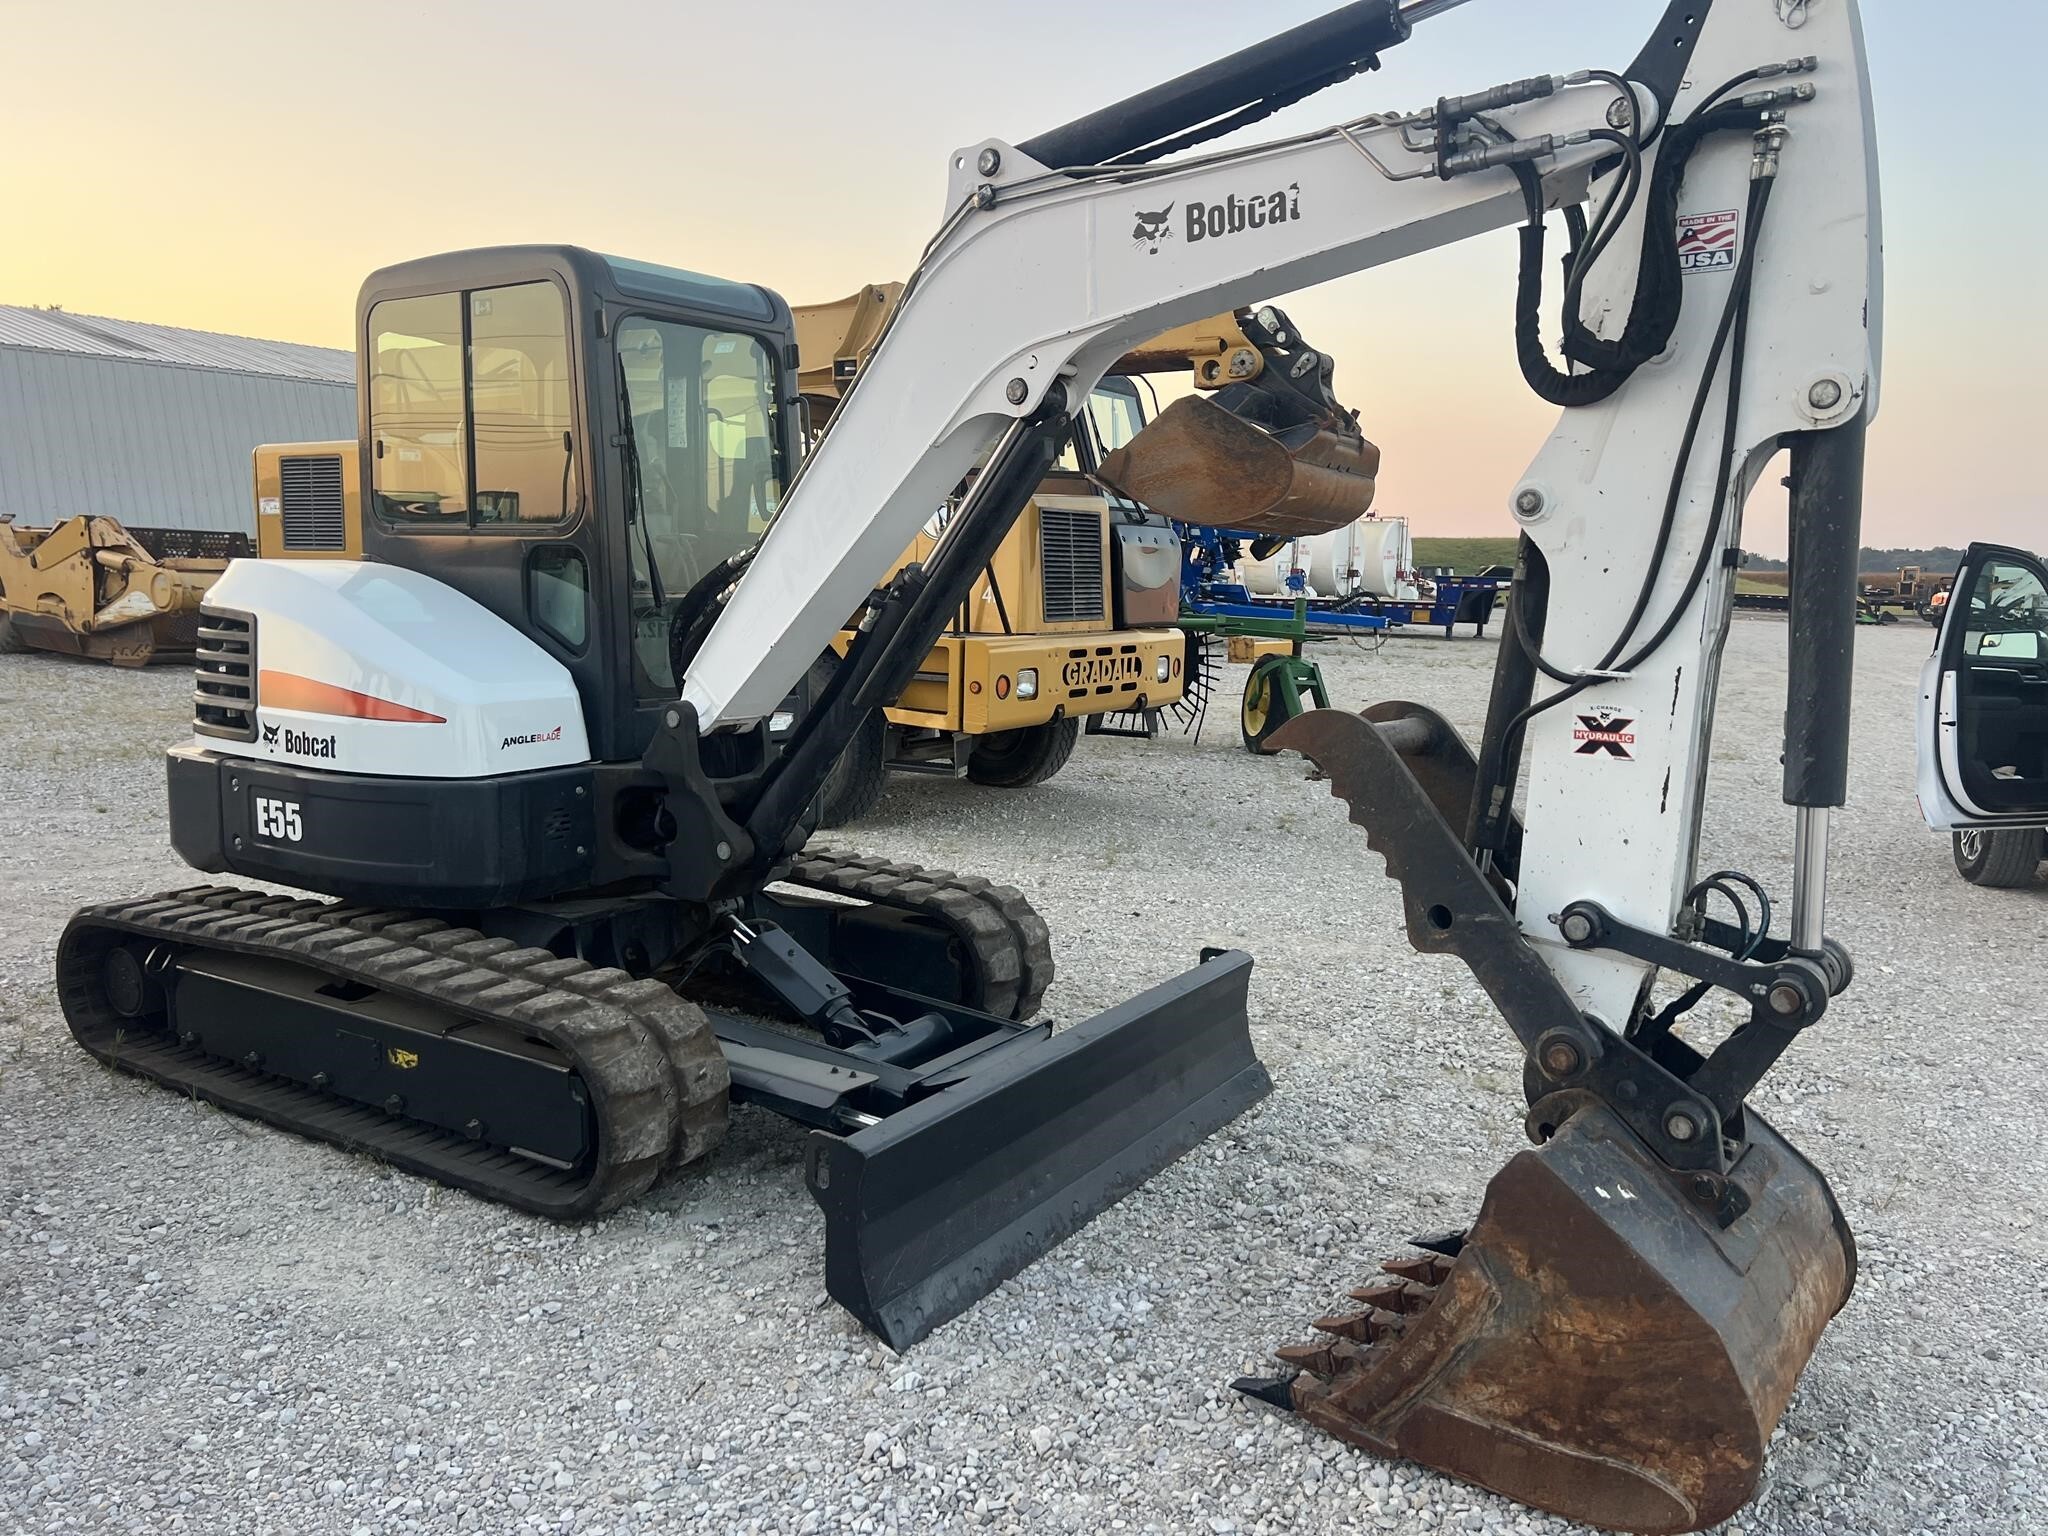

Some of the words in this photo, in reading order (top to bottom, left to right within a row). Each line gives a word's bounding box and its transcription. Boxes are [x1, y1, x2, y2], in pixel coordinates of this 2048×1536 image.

[1186, 181, 1301, 243] Bobcat
[1680, 217, 1704, 226] MADE
[1718, 214, 1733, 222] THE
[1679, 251, 1730, 269] USA
[1063, 657, 1142, 686] GRADALL
[284, 729, 337, 759] Bobcat
[500, 731, 561, 750] ANGLEBLADE
[1575, 731, 1633, 743] HYDRAULIC
[256, 797, 303, 842] E55
